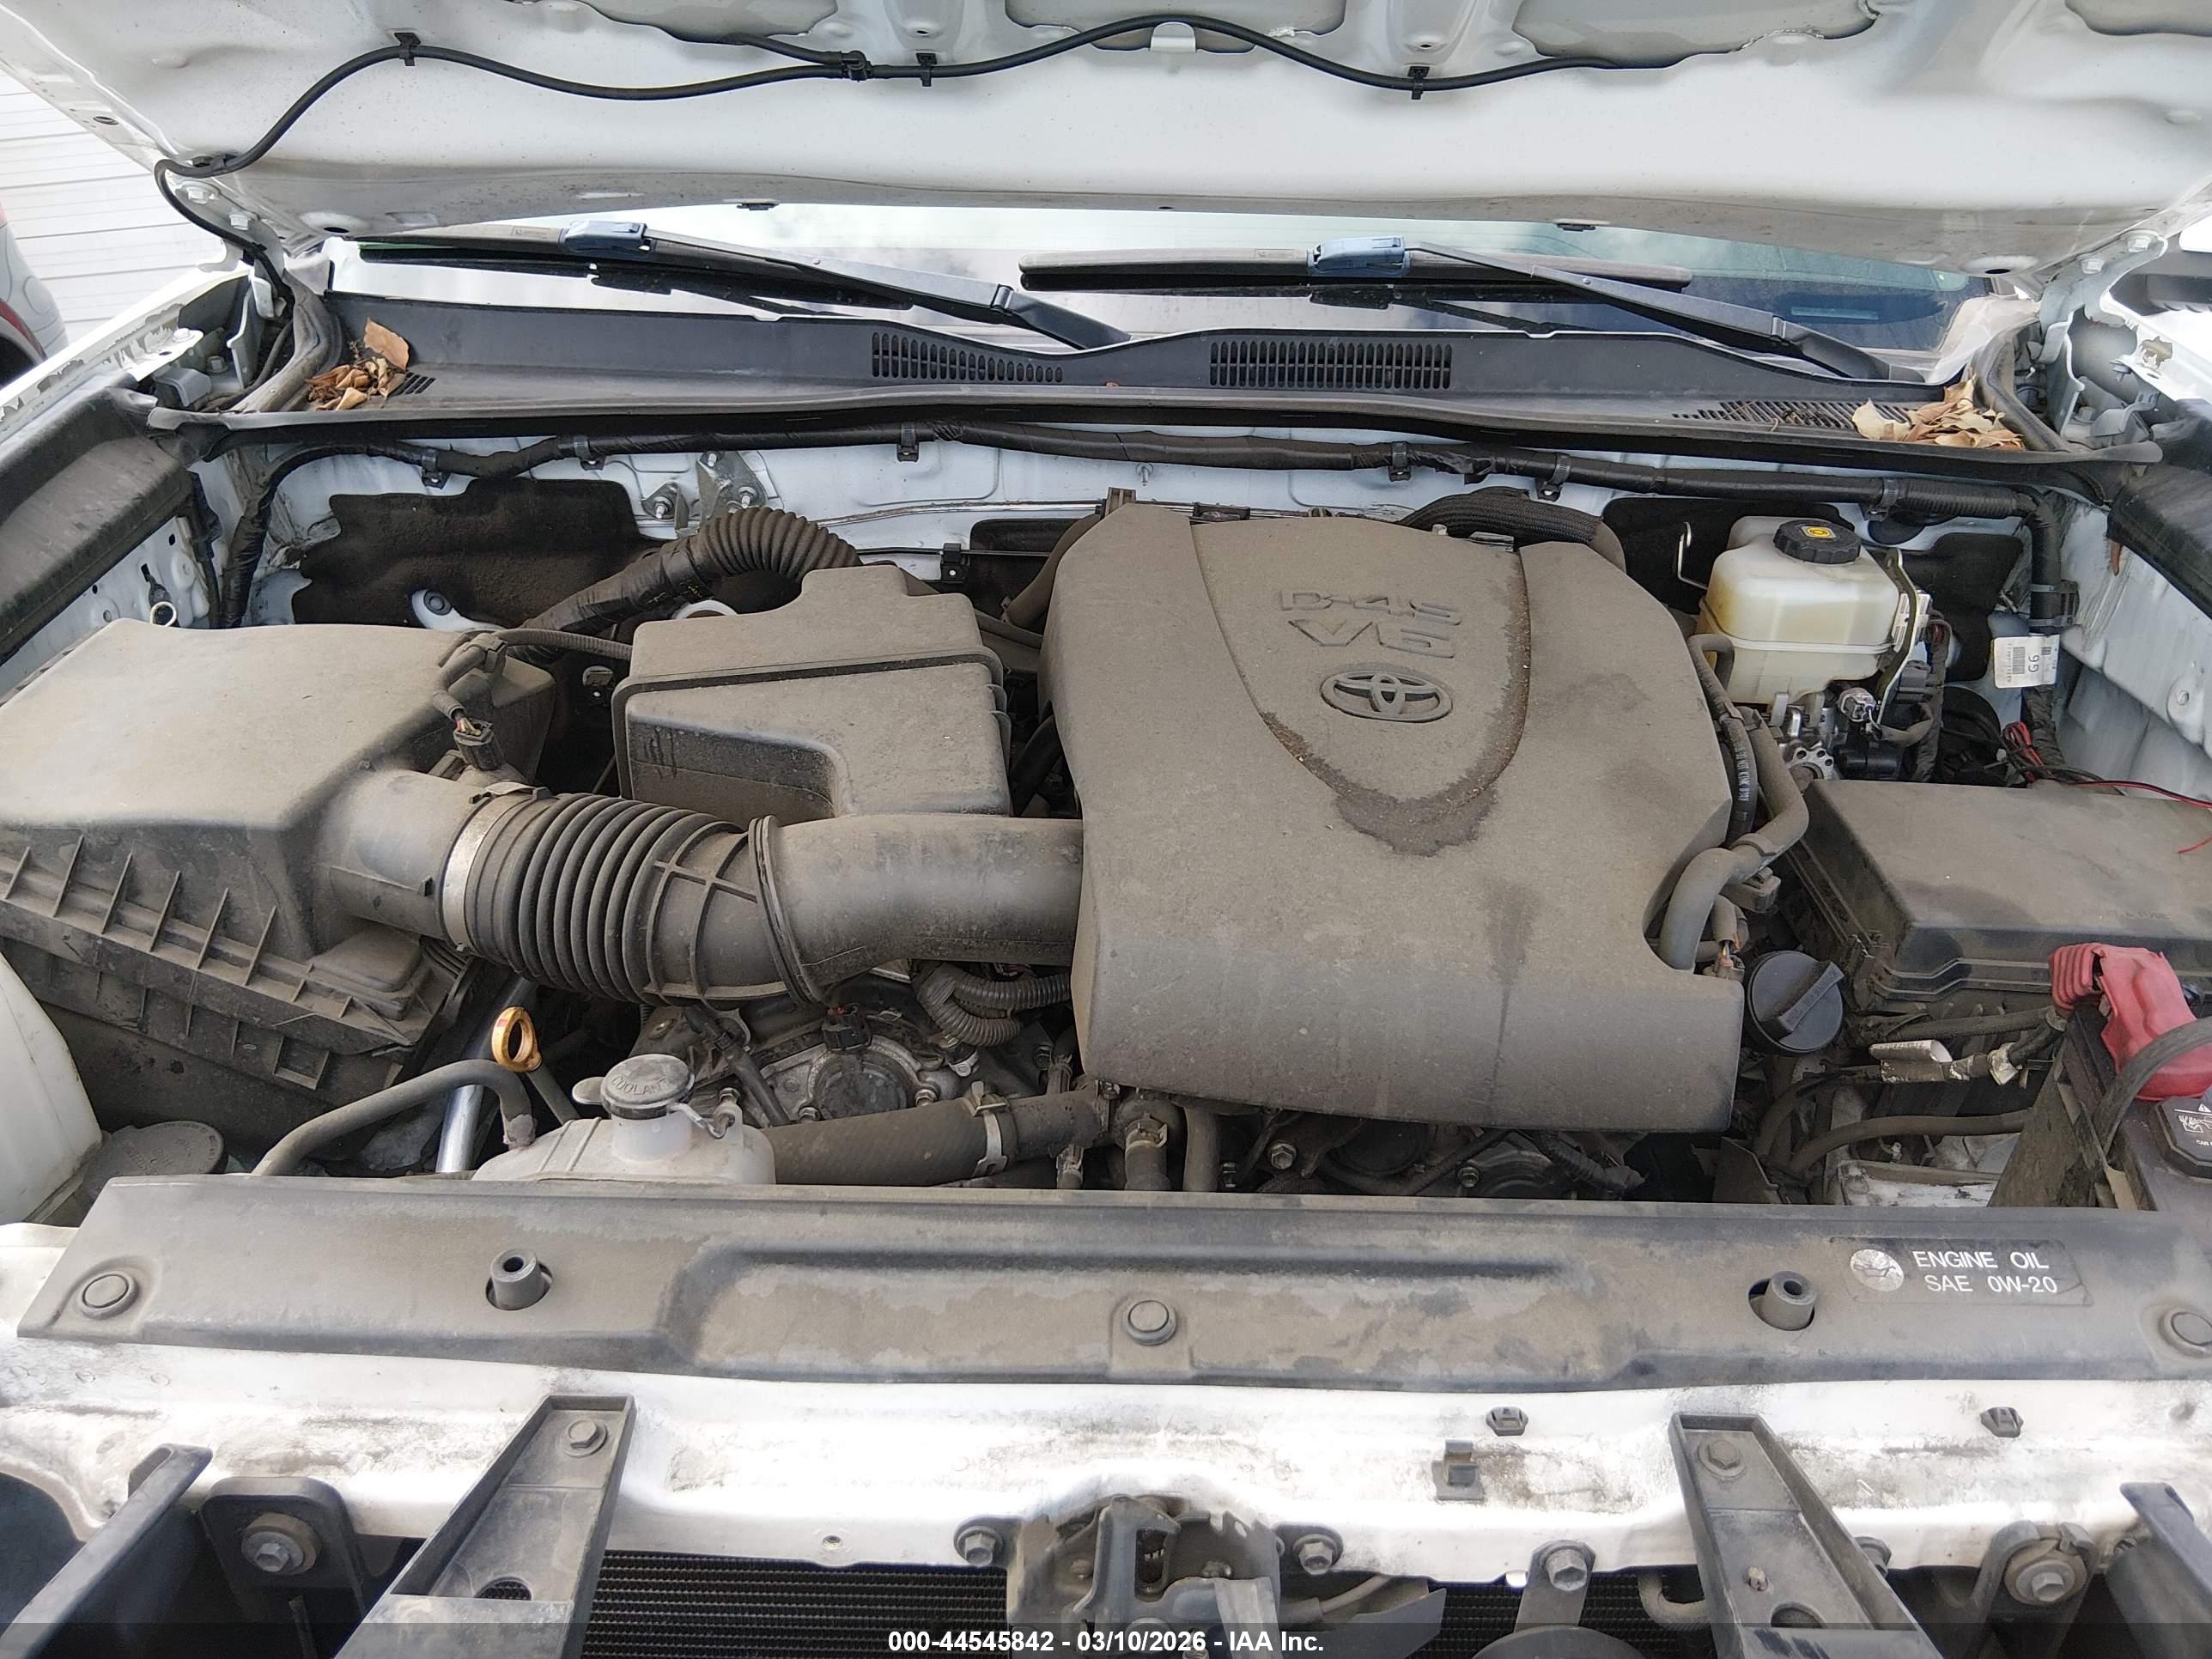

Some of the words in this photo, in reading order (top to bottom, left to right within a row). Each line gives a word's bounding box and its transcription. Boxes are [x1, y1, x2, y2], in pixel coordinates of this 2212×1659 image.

[611, 1076, 672, 1096] COOLANT
[1911, 1250, 1999, 1269] ENGINE
[2009, 1251, 2050, 1270] OIL
[1923, 1274, 1973, 1292] SAE
[1986, 1275, 2058, 1294] 0W-20
